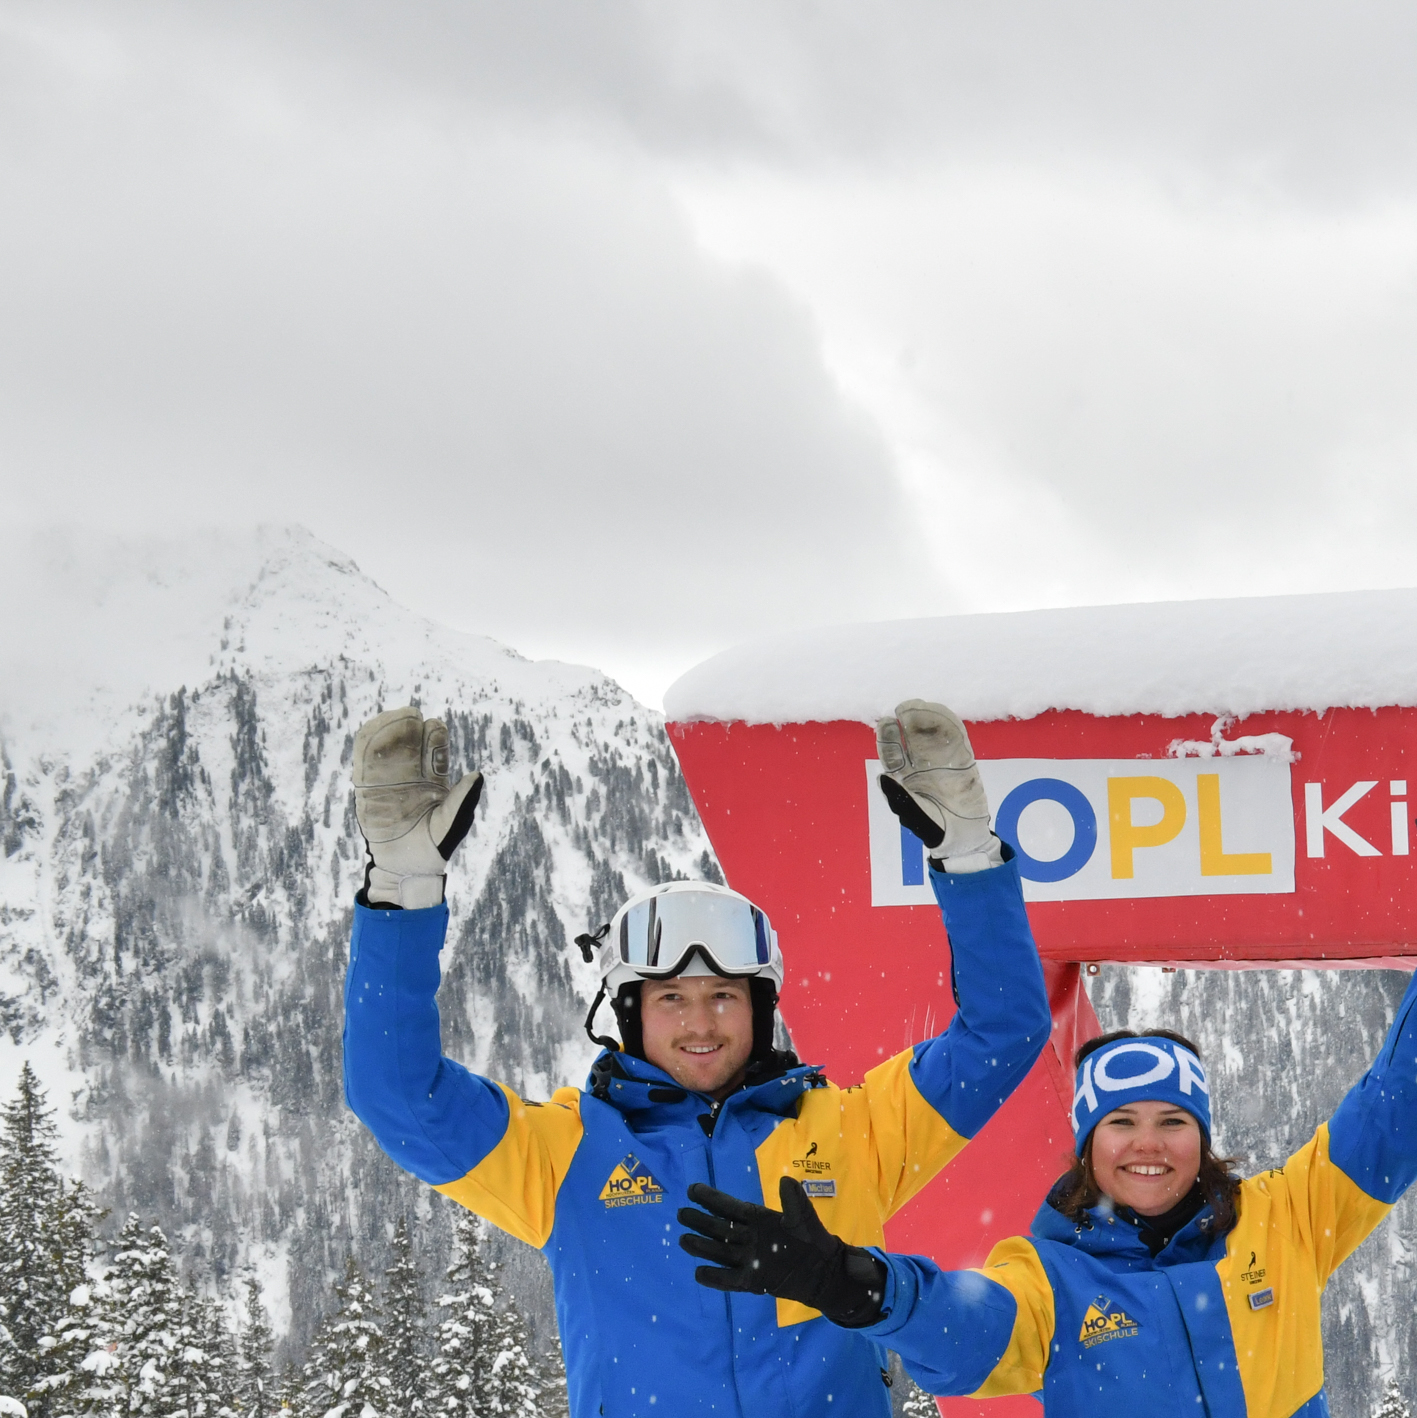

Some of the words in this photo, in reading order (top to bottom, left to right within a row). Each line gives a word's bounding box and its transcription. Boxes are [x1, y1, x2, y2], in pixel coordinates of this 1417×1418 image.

[901, 773, 1273, 887] OPL
[792, 1159, 832, 1172] STEINER
[808, 1181, 834, 1194] Michael
[604, 1194, 663, 1209] SKISCHULE
[1240, 1268, 1267, 1283] STEINER
[1083, 1327, 1139, 1349] SKISCHULE
